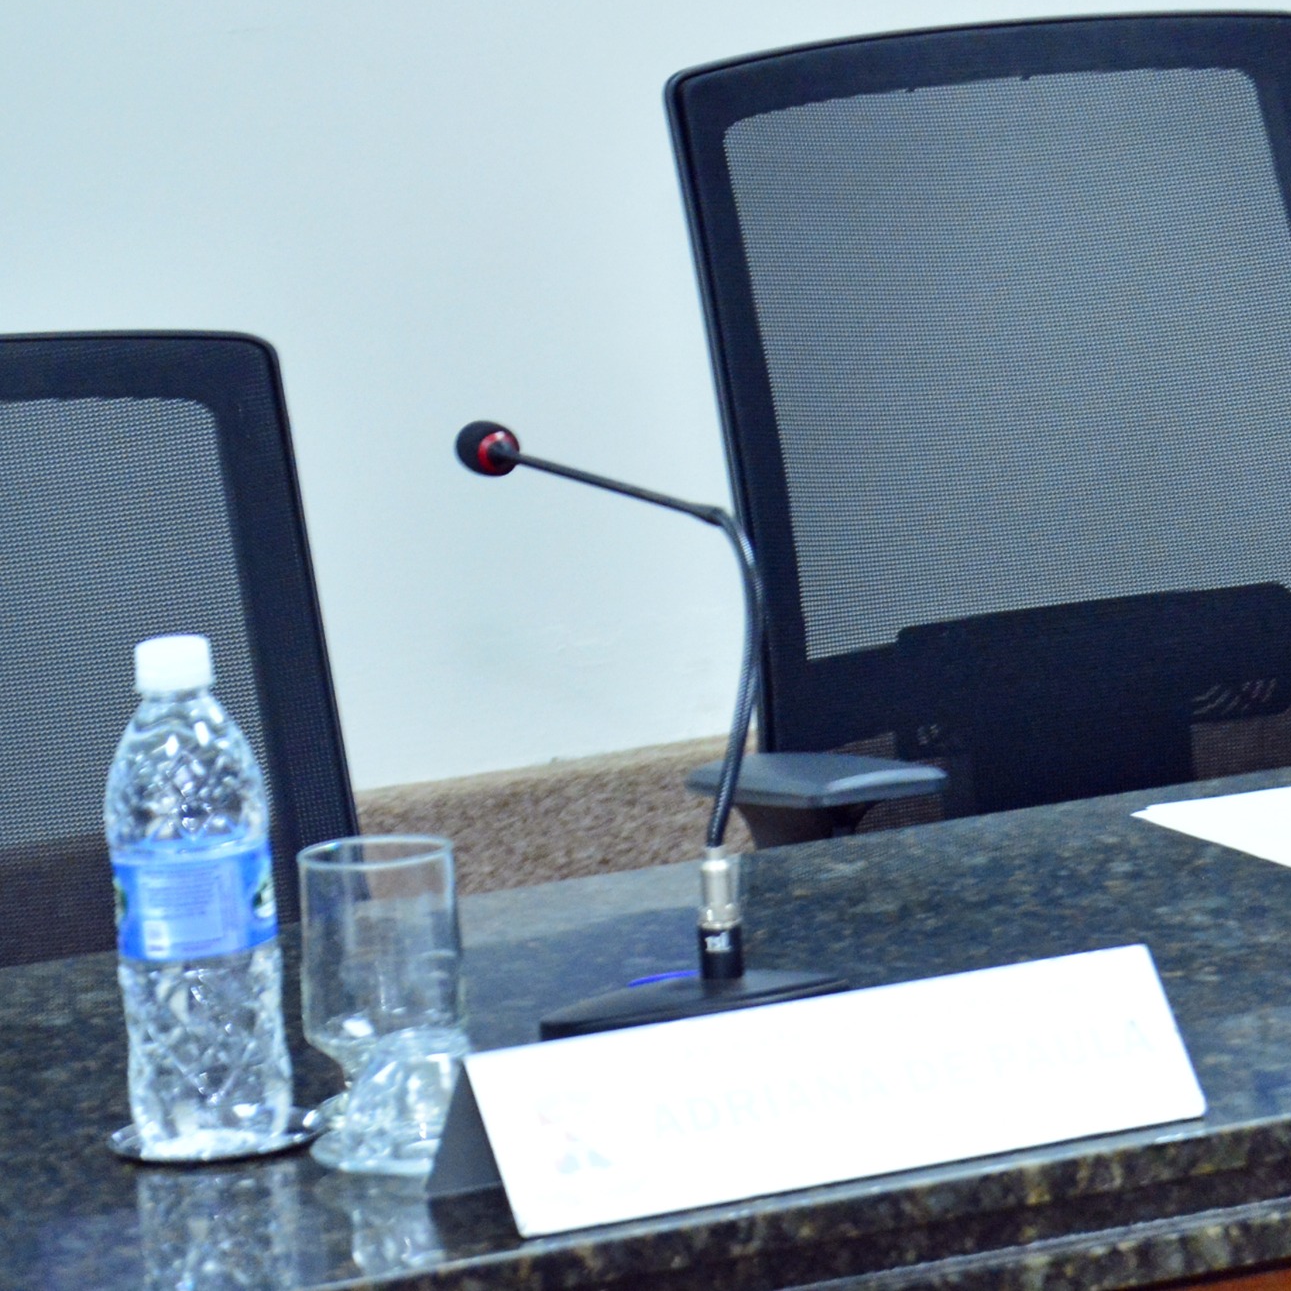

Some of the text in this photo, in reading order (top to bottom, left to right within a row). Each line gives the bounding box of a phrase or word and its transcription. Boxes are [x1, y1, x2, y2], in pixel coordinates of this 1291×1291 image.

[652, 1016, 1156, 1139] ADRIANA DE PAULA
